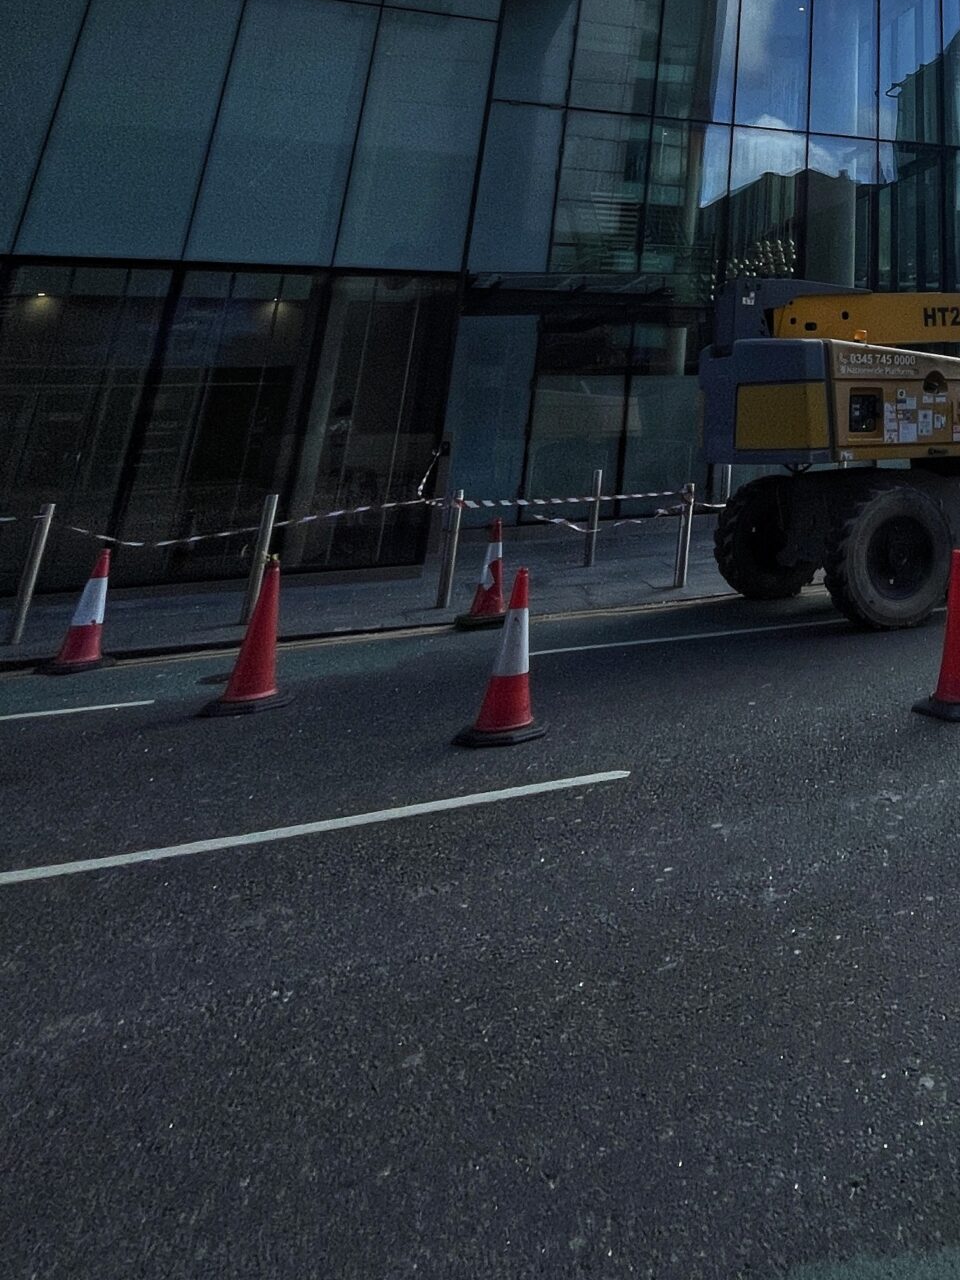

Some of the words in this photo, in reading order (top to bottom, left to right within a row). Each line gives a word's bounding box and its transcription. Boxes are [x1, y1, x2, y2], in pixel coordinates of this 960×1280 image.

[850, 353, 873, 365] 0345
[875, 354, 892, 365] 745
[894, 355, 916, 365] 0000
